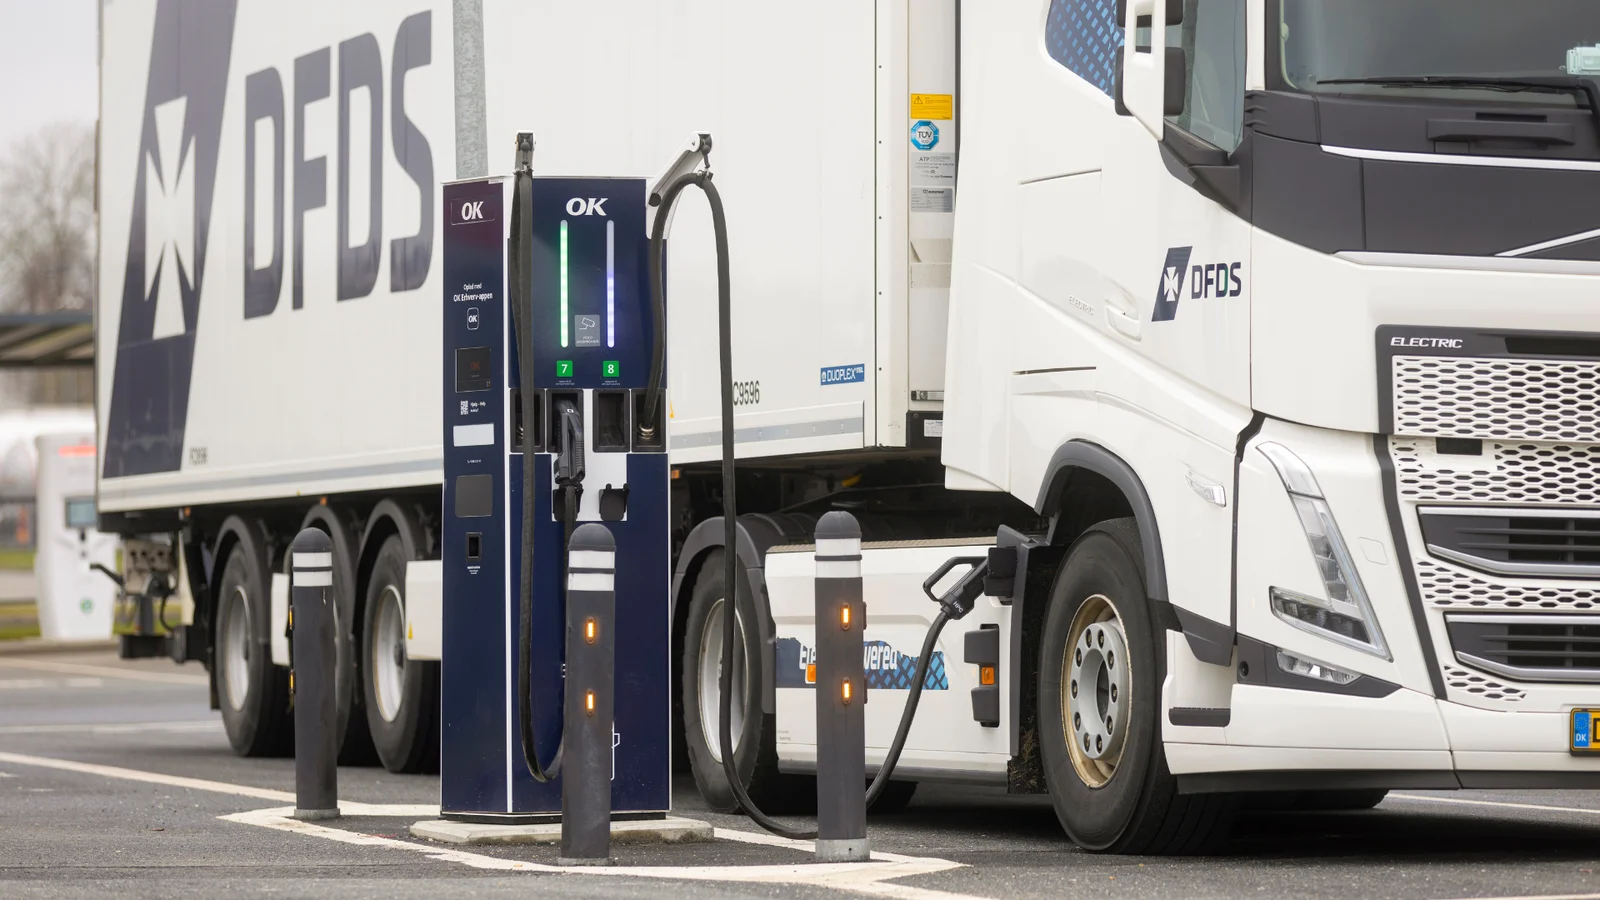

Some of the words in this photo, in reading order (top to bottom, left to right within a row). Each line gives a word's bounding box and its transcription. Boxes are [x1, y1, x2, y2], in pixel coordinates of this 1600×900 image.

[244, 9, 434, 320] DFDS
[461, 201, 484, 221] OK
[566, 197, 609, 216] OK
[1191, 262, 1242, 299] DFDS
[453, 294, 461, 302] OK
[468, 315, 478, 323] OK
[1390, 337, 1463, 348] ELECTRIC
[561, 363, 568, 374] 7
[607, 363, 615, 374] 8
[827, 368, 856, 382] DUOPLEX
[1575, 733, 1587, 742] DK
